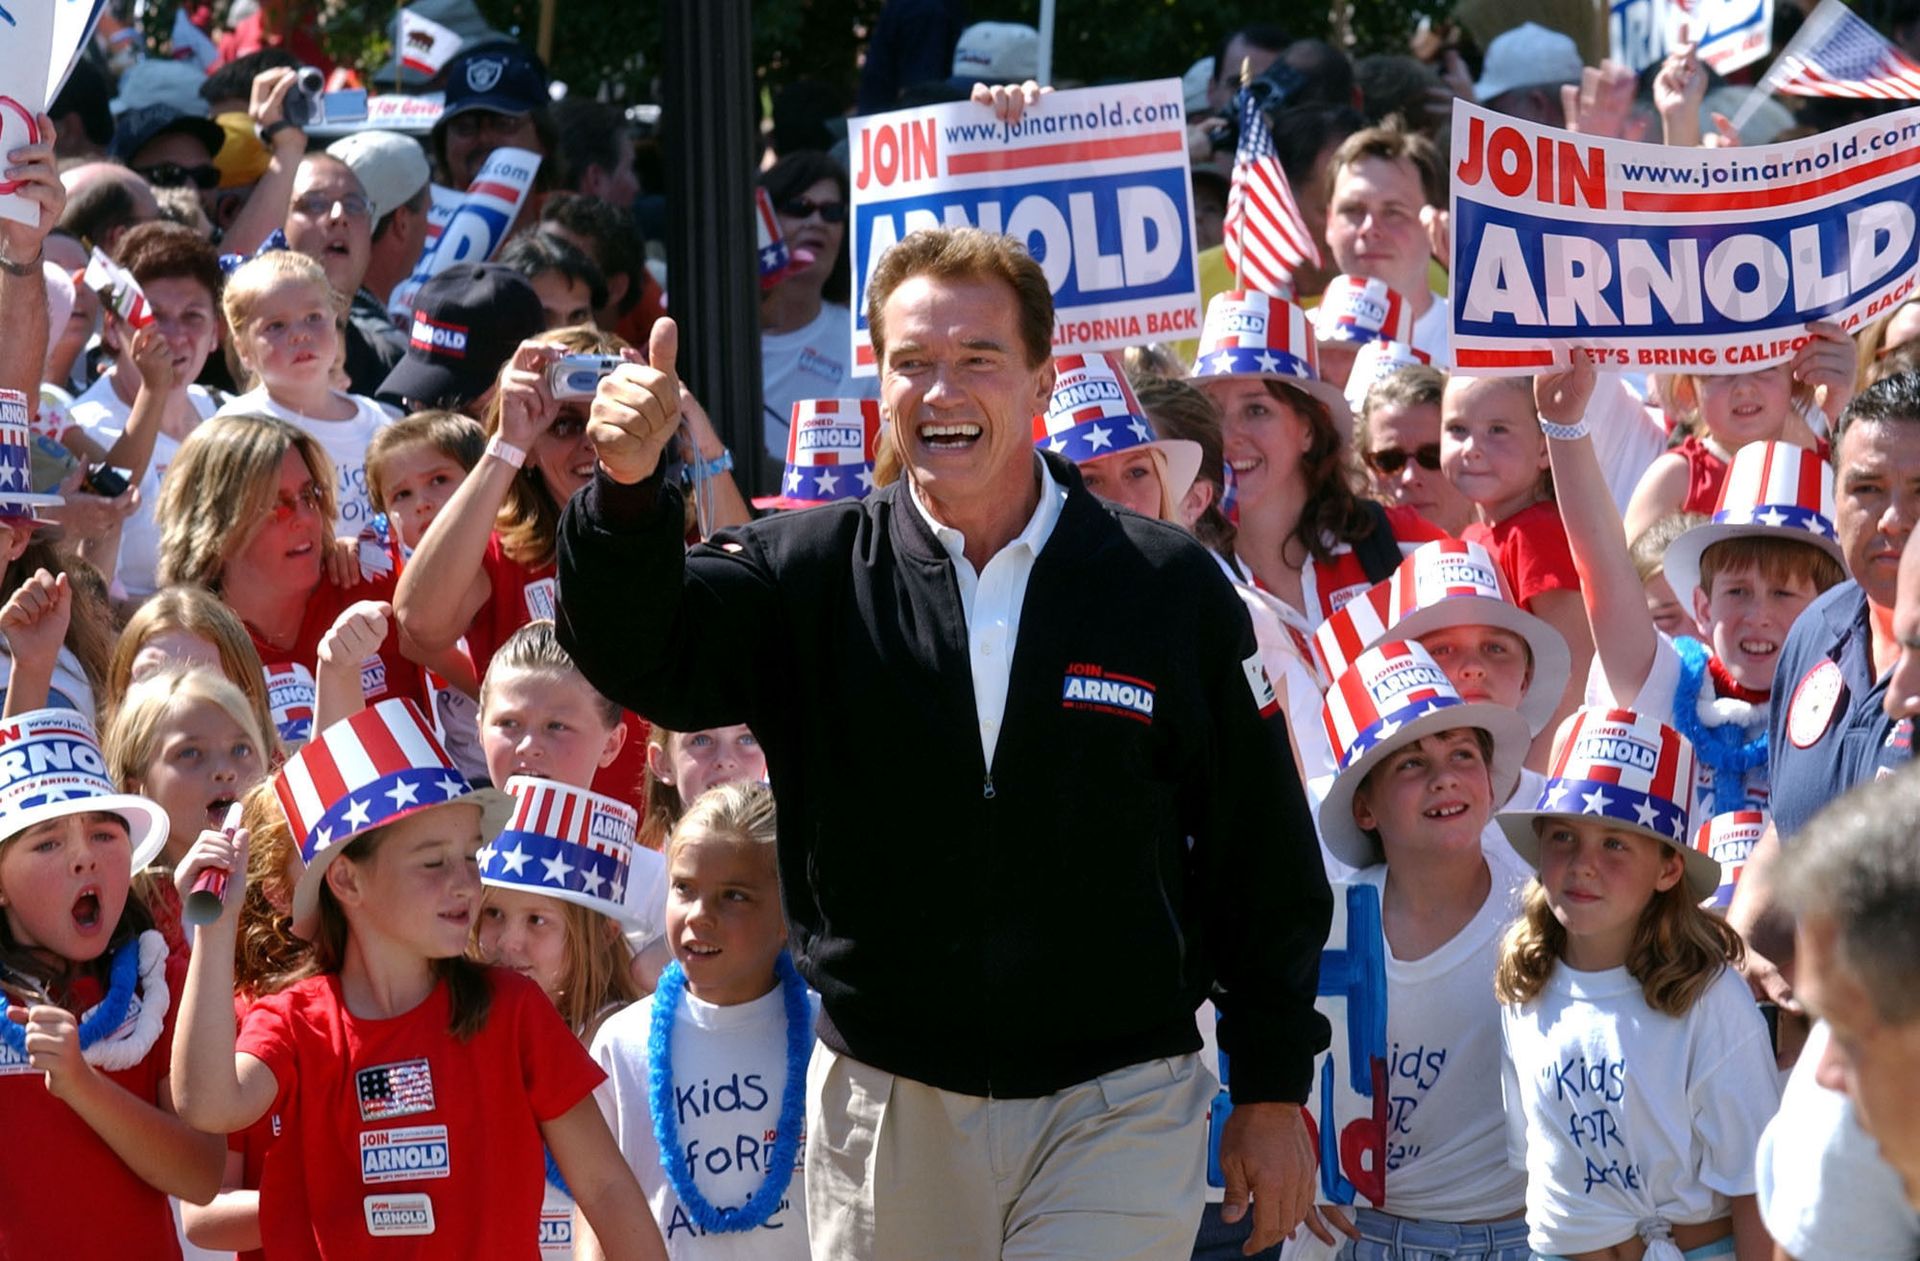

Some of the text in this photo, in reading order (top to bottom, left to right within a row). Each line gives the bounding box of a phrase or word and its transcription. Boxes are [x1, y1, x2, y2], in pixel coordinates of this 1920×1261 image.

[856, 101, 1180, 190] JOIN www.joinarnold.com
[1457, 116, 1608, 210] JOIN
[1462, 200, 1917, 327] ARNOLD
[1147, 307, 1198, 333] BACK
[1638, 348, 1716, 366] BRING
[1866, 273, 1915, 319] BACK
[1051, 381, 1121, 413] ARNOLD
[1053, 373, 1086, 391] OINED
[800, 428, 861, 449] ARNOLD
[1066, 662, 1103, 678] JOIN
[1065, 678, 1154, 713] ARNOLD
[1714, 840, 1753, 863] ARN
[1391, 1043, 1447, 1090] ids
[675, 1073, 769, 1125] Kids
[362, 1132, 390, 1147] JOIN
[365, 1144, 447, 1173] ARNOLD
[373, 1211, 427, 1226] ARNOLD
